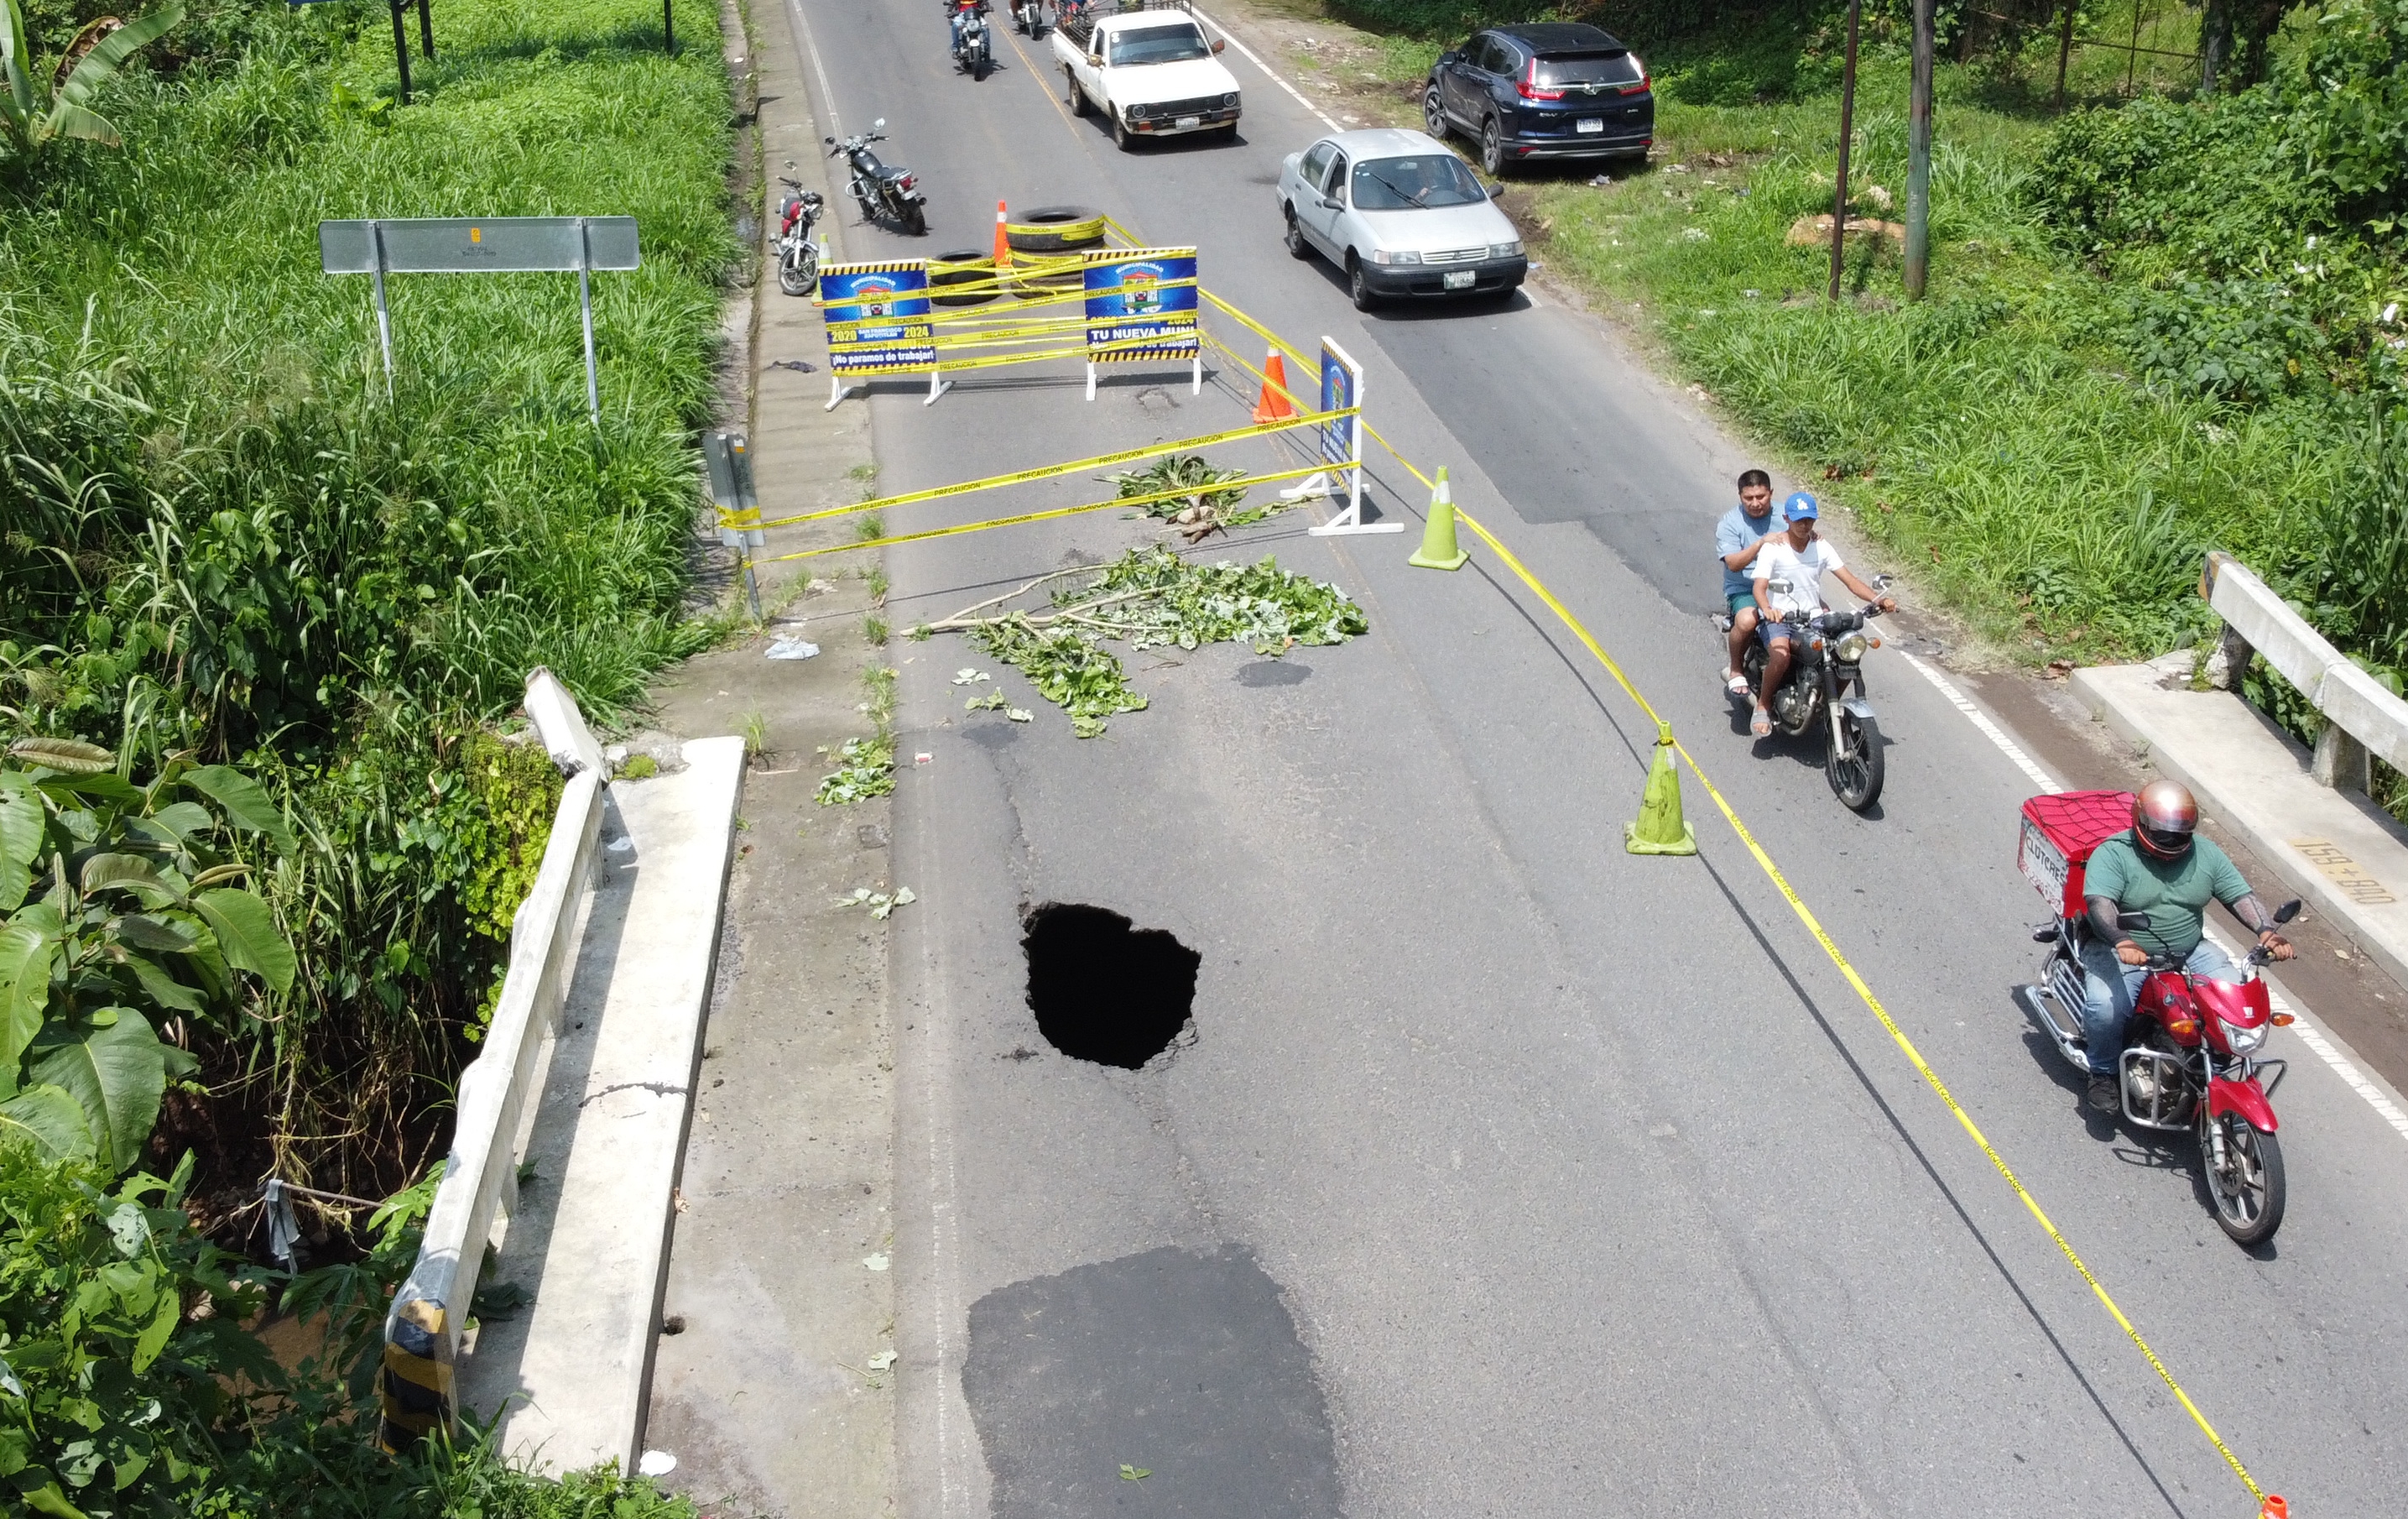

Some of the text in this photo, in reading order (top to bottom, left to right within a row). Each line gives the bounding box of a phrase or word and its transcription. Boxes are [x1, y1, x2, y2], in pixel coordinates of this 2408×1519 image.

[1116, 262, 1164, 274] MUNICIPALIDAD
[831, 330, 857, 342] 2020
[904, 326, 929, 338] 2024
[1091, 330, 1109, 341] TU
[1113, 327, 1157, 339] NUEVA
[848, 353, 884, 365] paramos
[898, 350, 934, 362] trabajar!
[934, 482, 981, 496] PRECAUCION
[1017, 466, 1063, 480] PRECAUCION
[1098, 450, 1144, 464] PRECAUCION
[1179, 434, 1223, 448] PRECAUCION
[1258, 419, 1301, 432] PRECAUCION
